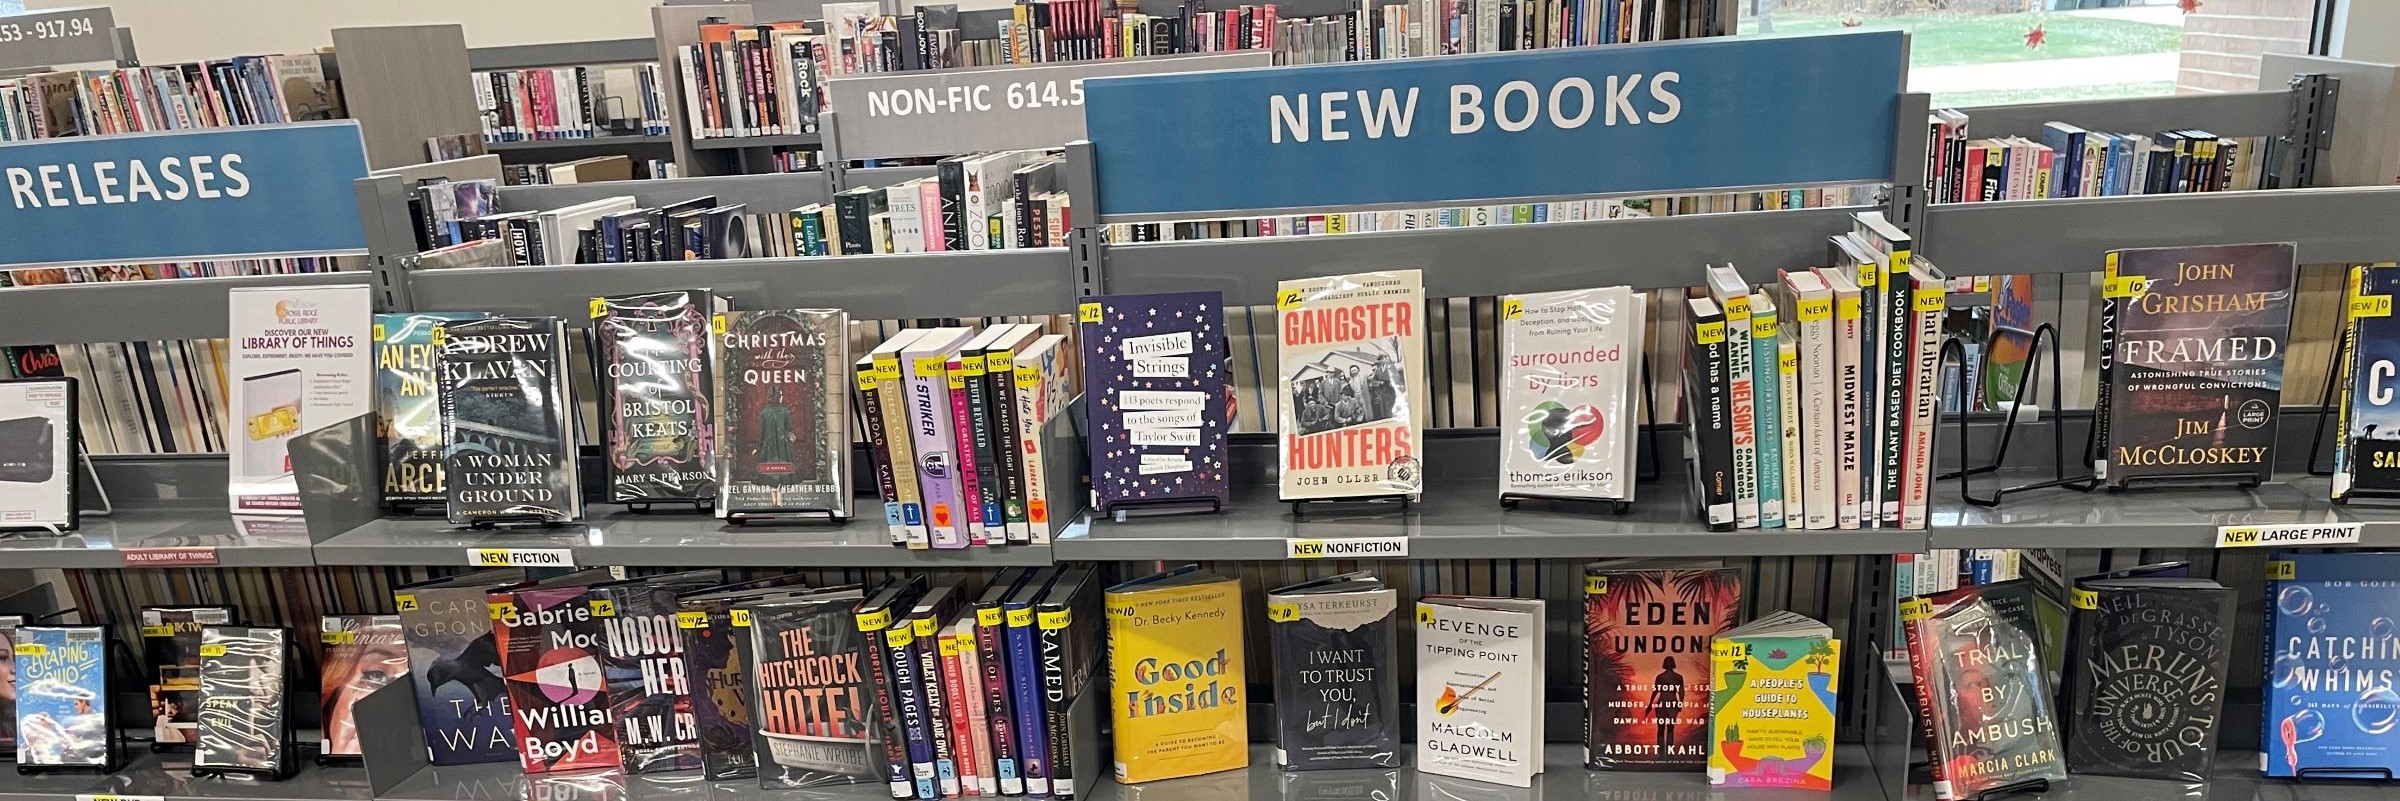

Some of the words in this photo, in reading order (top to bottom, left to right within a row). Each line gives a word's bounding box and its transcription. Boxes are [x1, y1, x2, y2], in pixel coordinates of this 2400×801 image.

[35, 17, 94, 39] 917.94
[868, 84, 992, 117] NON-FIC
[1006, 79, 1085, 109] 614.5
[1269, 87, 1419, 145] NEW
[1449, 71, 1682, 136] BOOKS
[6, 153, 251, 209] RELEASES
[890, 204, 916, 213] TREES
[1033, 209, 1042, 245] PESTS
[512, 231, 525, 254] HOW
[795, 232, 804, 252] EAT
[2175, 262, 2236, 286] JOHN
[1805, 304, 1829, 315] NEW
[1920, 296, 1943, 306] NEW
[2141, 291, 2266, 315] GRISHAM
[1284, 301, 1412, 346] GANGSTER
[1702, 328, 1725, 338] NEW
[1894, 289, 1906, 357] COOKBOOK
[1927, 310, 1940, 335] hat
[242, 337, 289, 349] LIBRARY
[292, 337, 308, 349] OF
[310, 336, 354, 349] THINGS
[724, 331, 827, 350] CHRISTMAS
[2100, 298, 2116, 371] AMED
[1129, 336, 1188, 356] Invisible
[1510, 344, 1621, 367] surrounded
[1739, 329, 1750, 374] WILLIE
[2123, 336, 2278, 365] FRAMED
[876, 364, 897, 373] NEW
[963, 362, 984, 371] NEW
[989, 358, 1010, 367] NEW
[1136, 360, 1186, 377] Strings
[1730, 337, 1740, 380] ANNIE
[401, 371, 426, 397] AN
[744, 369, 806, 385] QUEEN
[1892, 360, 1903, 386] DIET
[1918, 338, 1937, 418] Librarian
[2368, 359, 2395, 406] C
[649, 378, 663, 398] of
[969, 378, 980, 405] TRUTH
[1844, 364, 1856, 427] MIDWEST
[2143, 383, 2196, 391] WRONGFUL
[2199, 381, 2267, 389] CONVICTIONS
[623, 399, 696, 418] BRISTOL
[916, 385, 936, 437] STRIKER
[1731, 381, 1754, 446] NELSON'S
[1891, 390, 1902, 427] BASED
[632, 420, 688, 438] KEATS
[974, 406, 987, 449] REVEALED
[1134, 431, 1168, 444] Taylor
[1169, 430, 1197, 442] Swift
[2174, 418, 2209, 439] JIM
[1288, 425, 1413, 471] HUNTERS
[1843, 430, 1855, 472] MAIZE
[1889, 430, 1900, 467] PLANT
[1916, 431, 1927, 469] AMANDA
[2118, 444, 2268, 466] McCLOSKEY
[454, 459, 462, 468] A
[468, 453, 552, 469] WOMAN
[465, 471, 543, 486] UNDER
[616, 473, 645, 484] MARY
[661, 471, 711, 481] PEARSON
[1296, 476, 1328, 486] JOHN
[1337, 474, 1380, 484] OLLER
[1509, 471, 1560, 482] thomas
[1563, 469, 1613, 481] erikson
[1735, 448, 1746, 500] COOKBOOK
[1745, 448, 1755, 499] CANNABIS
[1887, 470, 1898, 490] THE
[459, 488, 553, 503] GROUND
[1913, 471, 1923, 502] JONES
[2224, 531, 2258, 543] NEW
[2261, 529, 2310, 541] LARGE
[2312, 527, 2355, 540] PRINT
[126, 553, 147, 561] ADULT
[148, 553, 177, 561] LIBRARY
[178, 552, 187, 560] OF
[188, 552, 214, 560] THINGS
[480, 552, 509, 564] NEW
[513, 552, 560, 564] FICTION
[1294, 544, 1323, 555] NEW
[1326, 542, 1401, 554] NONFICTION
[500, 602, 589, 628] Gabrie
[1297, 602, 1316, 610] YSA
[1318, 599, 1378, 610] TERKEURST
[1624, 601, 1711, 626] EDEN
[2097, 593, 2147, 618] NEIL
[1014, 614, 1033, 622] NEW
[1134, 617, 1149, 627] Dr.
[1152, 613, 1182, 626] Becky
[1184, 608, 1226, 621] Kennedy
[1426, 618, 1520, 639] REVENGE
[415, 621, 484, 637] GRON
[603, 613, 685, 658] NOBOD
[888, 635, 908, 643] NEW
[779, 626, 816, 659] THE
[957, 639, 976, 647] NEW
[1426, 644, 1475, 658] TIPPING
[1479, 651, 1519, 663] POINT
[2153, 624, 2221, 661] TYSON
[1041, 628, 1064, 702] RAMED
[1309, 651, 1314, 664] I
[1316, 649, 1364, 664] WANT
[1953, 642, 2023, 669] TRIAL
[639, 657, 690, 698] HER
[759, 651, 863, 689] HITCHCOCK
[1134, 648, 1230, 686] Good
[1299, 670, 1322, 684] TO
[1324, 668, 1375, 683] TRUST
[2087, 643, 2219, 707] MERLIN'S
[892, 645, 911, 685] ROUGH
[902, 691, 919, 728] PAGES
[1750, 679, 1757, 688] A
[1759, 678, 1804, 689] PEOPLE'S
[2301, 667, 2400, 692] WHIMS
[206, 700, 238, 709] SPEAK
[1127, 680, 1237, 719] Inside
[1319, 688, 1357, 704] YOU,
[1608, 701, 1649, 709] MURDER,
[1665, 700, 1700, 709] UTOPIA
[1754, 694, 1783, 704] GUIDE
[1785, 694, 1797, 704] TO
[1981, 684, 2008, 704] BY
[2093, 673, 2184, 717] UNIVERSE
[450, 695, 512, 719] THE
[1306, 702, 1333, 733] but
[1333, 708, 1339, 729] I
[1341, 702, 1371, 730] don't
[1742, 709, 1809, 720] HOUSEPLANTS
[211, 719, 234, 728] EVIL
[1057, 712, 1067, 733] JOHN
[1431, 721, 1513, 743] MALCOLM
[1651, 717, 1683, 725] WORLD
[1952, 715, 2052, 749] AMBUSH
[525, 730, 599, 764] Boyd
[773, 742, 822, 761] STEPHANIE
[1059, 734, 1070, 767] GRISHAM
[1428, 739, 1518, 762] GLADWELL
[1604, 744, 1661, 756] ABBOTT
[1667, 744, 1707, 755] KAHL
[1958, 762, 2009, 779] MARCIA
[2014, 749, 2057, 769] CLARK
